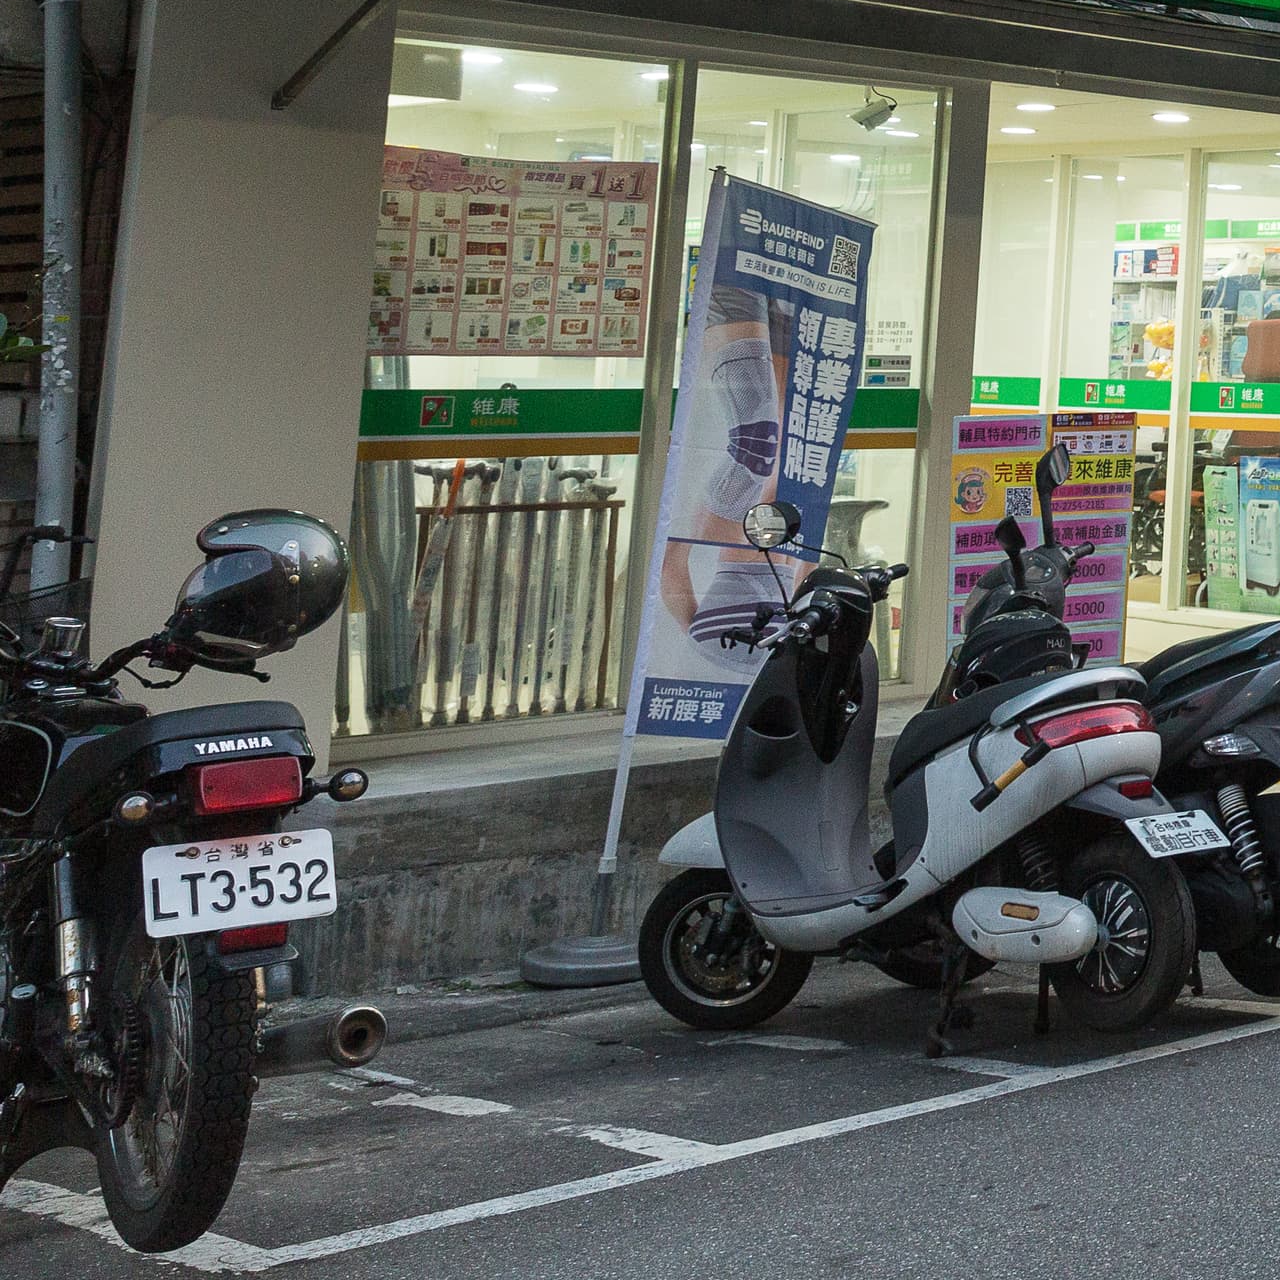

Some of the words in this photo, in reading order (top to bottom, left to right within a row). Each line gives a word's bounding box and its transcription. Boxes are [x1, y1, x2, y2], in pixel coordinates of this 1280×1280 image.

[762, 219, 825, 251] BAUERFEIND
[828, 283, 852, 299] LIFE
[471, 395, 520, 418] 維康
[801, 315, 858, 489] 專業護具
[959, 426, 1042, 443] 輔具特約門市
[653, 682, 725, 701] LumboTrain
[648, 696, 725, 726] 新腰寧
[194, 736, 274, 756] YAMAHA
[205, 840, 275, 864] 台灣省
[1146, 828, 1223, 854] 電動自行車
